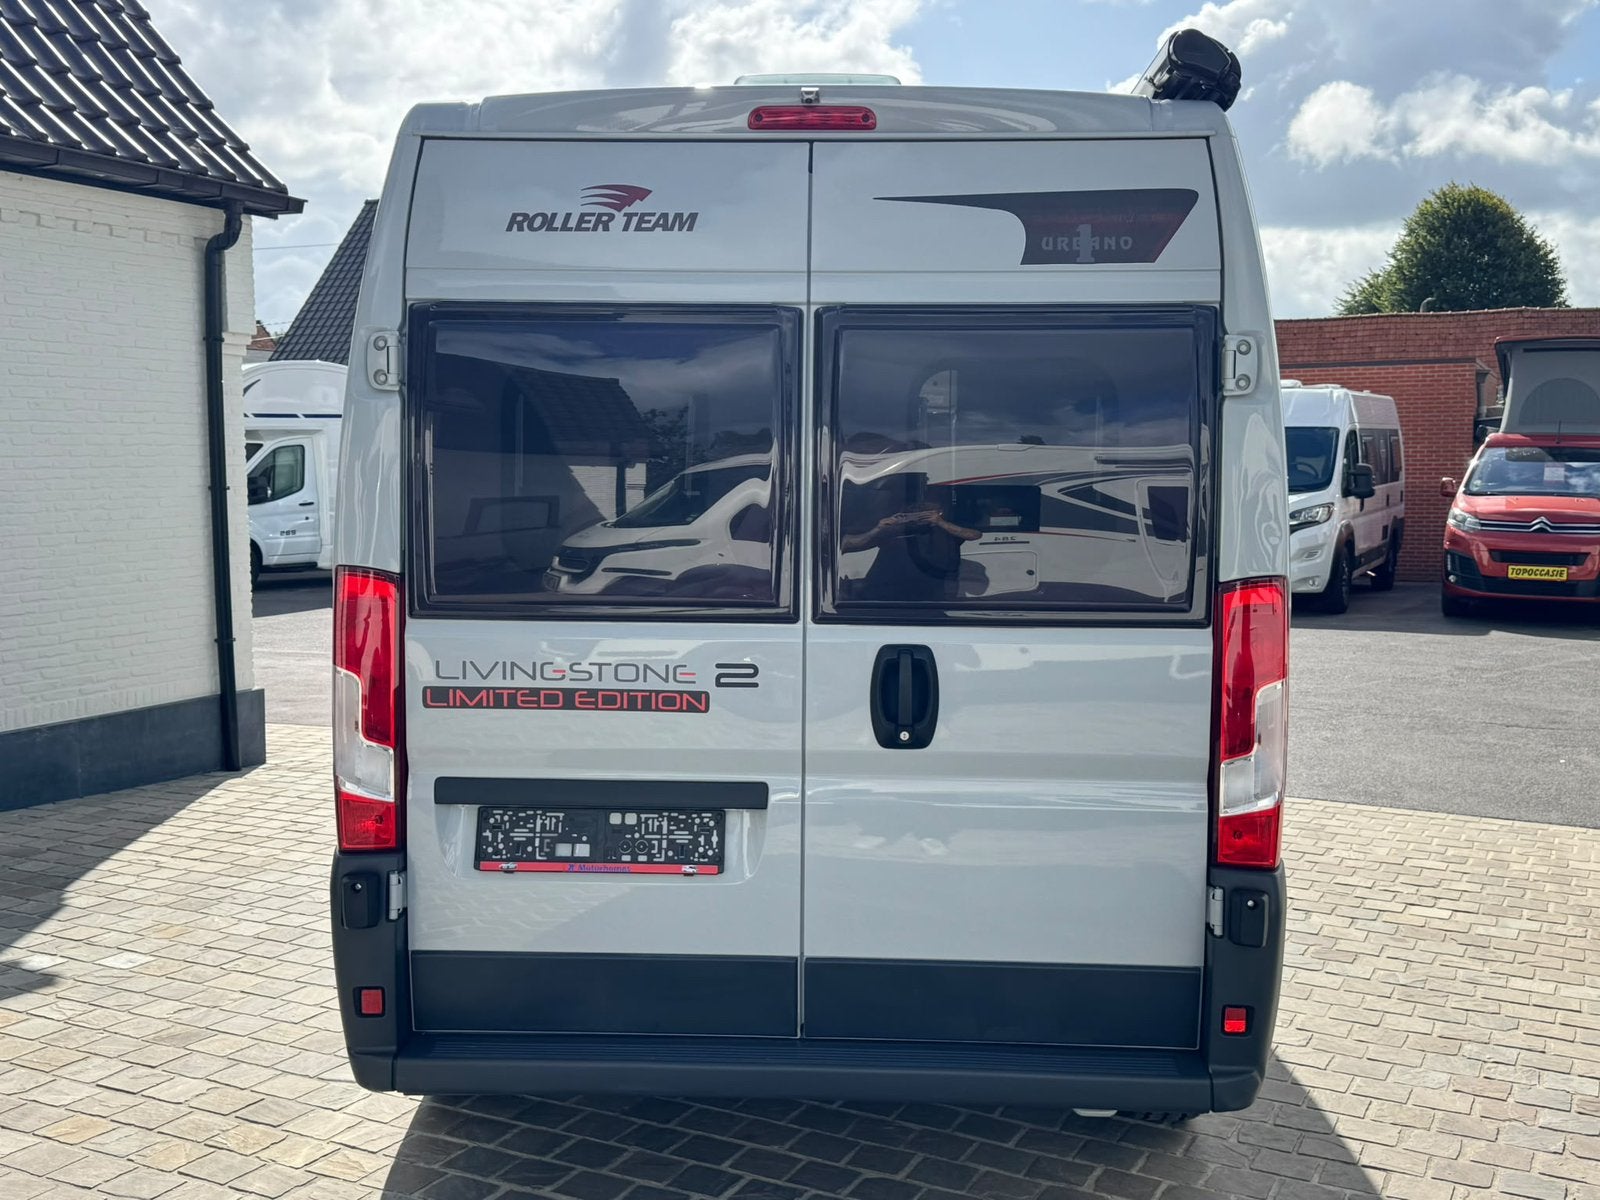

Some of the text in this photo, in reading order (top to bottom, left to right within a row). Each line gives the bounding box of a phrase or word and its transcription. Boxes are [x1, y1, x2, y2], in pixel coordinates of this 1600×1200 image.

[505, 212, 699, 232] ROLLER TEAM
[1510, 567, 1566, 578] TOPOCCASIE
[435, 660, 760, 688] LIVINGSTONE 2
[425, 688, 707, 711] LIMITED EDITION
